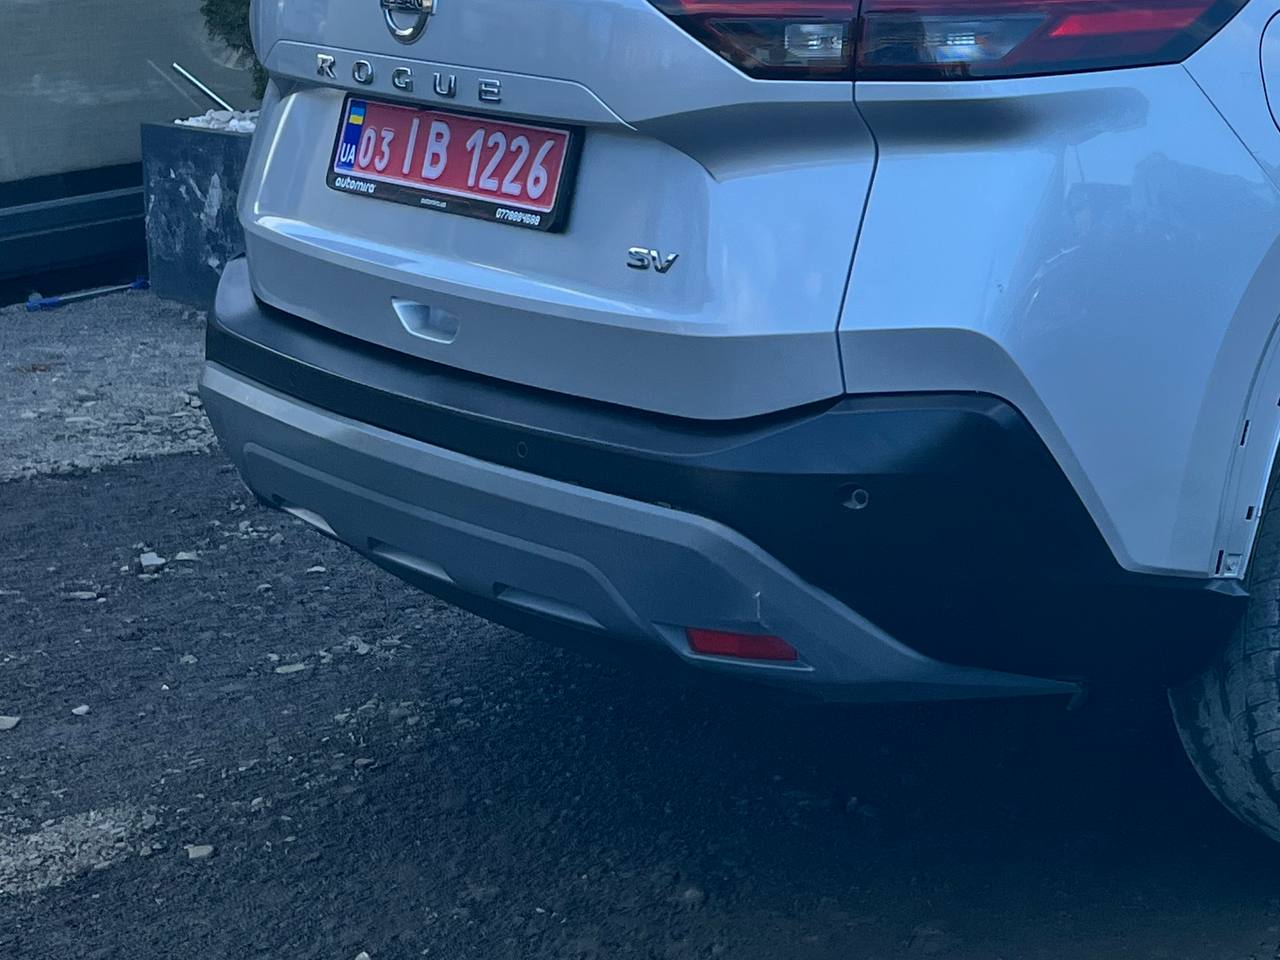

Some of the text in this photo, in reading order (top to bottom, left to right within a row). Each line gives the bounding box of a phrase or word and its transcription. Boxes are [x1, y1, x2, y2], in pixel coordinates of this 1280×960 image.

[316, 53, 503, 103] ROGUE
[340, 142, 356, 164] UA
[358, 117, 556, 200] 03 IB 1226
[335, 176, 376, 193] automira
[626, 246, 679, 273] SV
